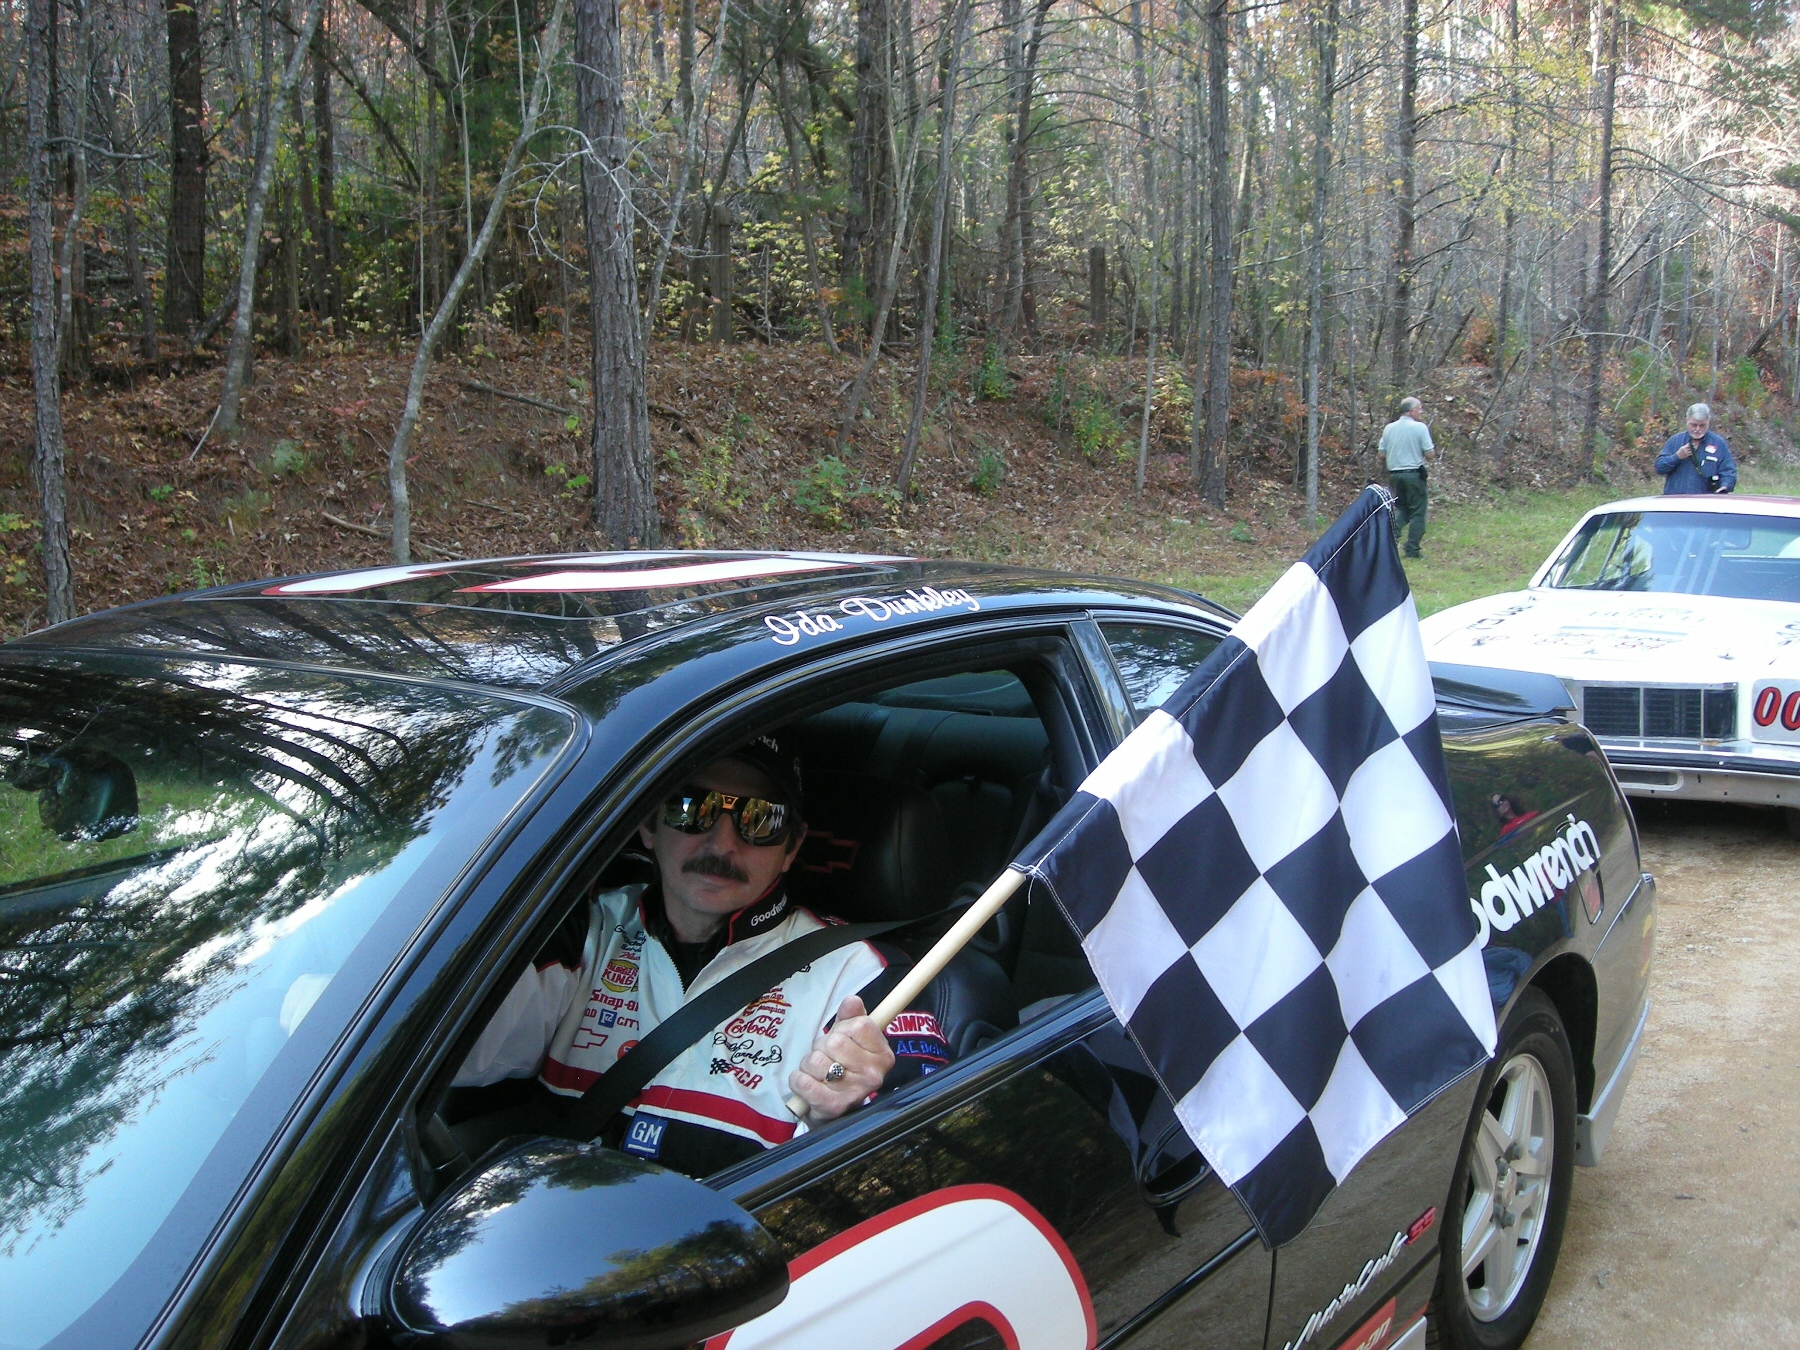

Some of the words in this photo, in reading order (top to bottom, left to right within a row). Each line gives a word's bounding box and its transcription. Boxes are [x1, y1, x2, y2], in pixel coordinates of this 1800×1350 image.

[764, 610, 843, 646] Ida
[602, 968, 634, 985] KING
[631, 1121, 663, 1146] GM
